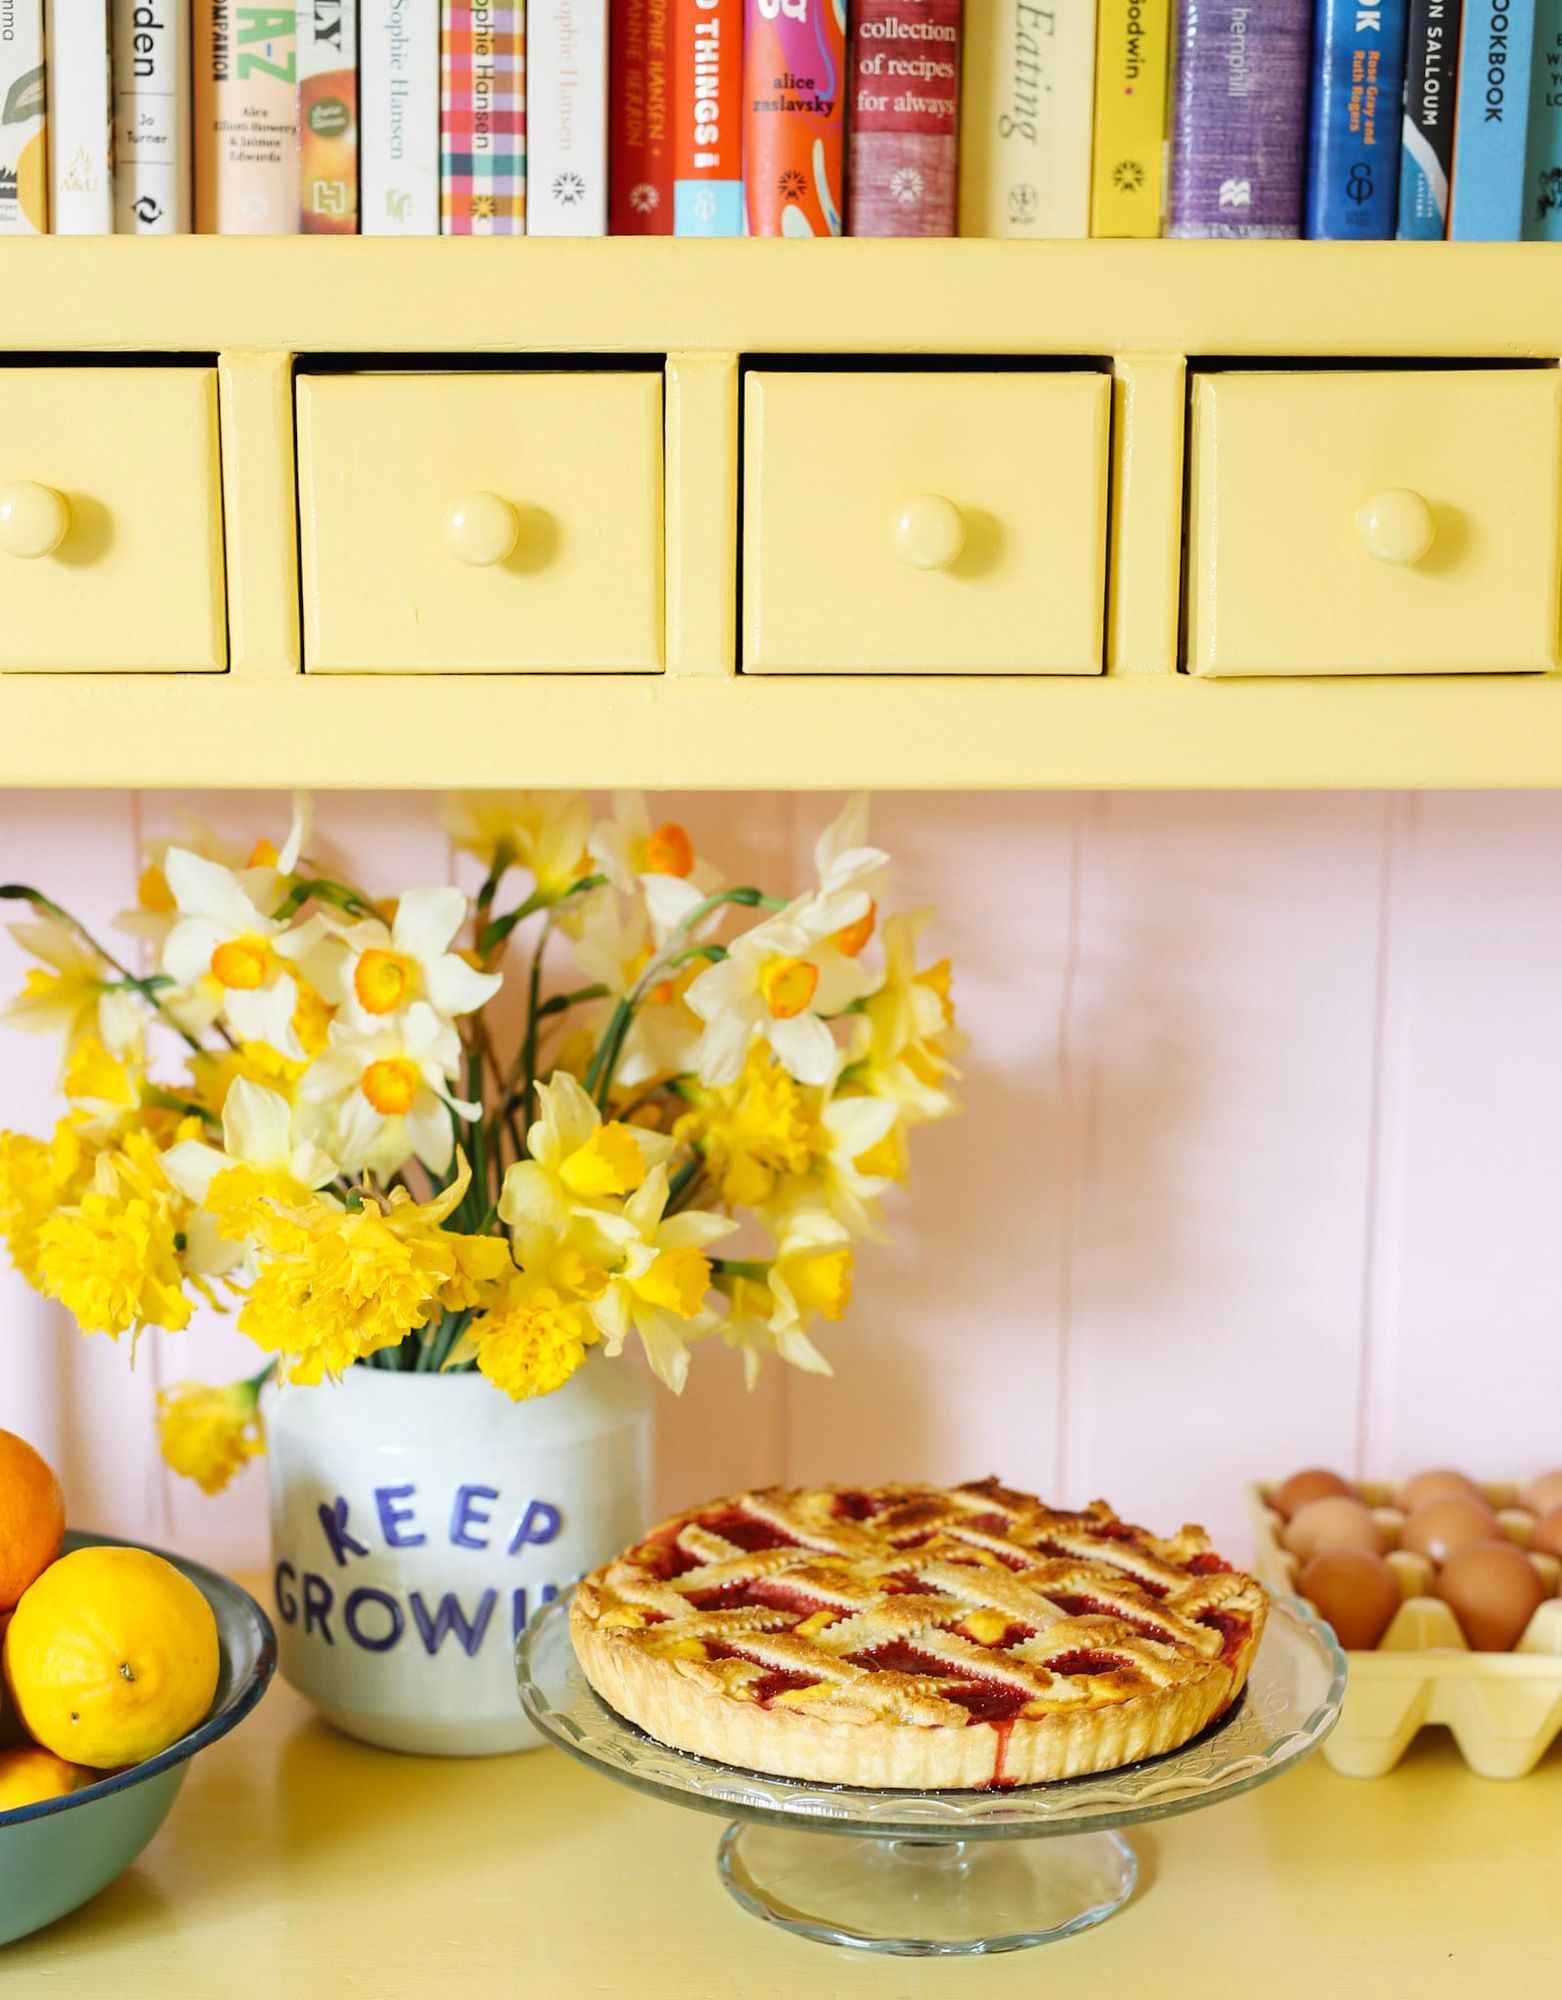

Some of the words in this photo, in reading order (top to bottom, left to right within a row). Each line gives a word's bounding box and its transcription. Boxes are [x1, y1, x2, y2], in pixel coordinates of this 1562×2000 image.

[132, 0, 164, 77] den
[236, 7, 296, 84] A-Z
[859, 17, 957, 41] collection
[859, 53, 886, 76] of
[887, 55, 955, 81] recipes
[1125, 0, 1146, 79] odwin
[1227, 7, 1252, 97] hemphill
[1352, 50, 1366, 83] Ruth
[1367, 50, 1381, 83] Rose
[474, 65, 495, 149] Hansen
[693, 17, 720, 146] THINGS
[753, 95, 835, 117] zaslavsky
[773, 73, 815, 90] alice
[856, 91, 888, 113] for
[894, 91, 955, 119] always
[999, 2, 1055, 145] Eating
[1363, 86, 1379, 118] Gray
[1422, 26, 1443, 126] SALLOUM
[127, 130, 167, 144] Turner
[390, 79, 409, 160] Hansen
[318, 1484, 565, 1567] KEEP
